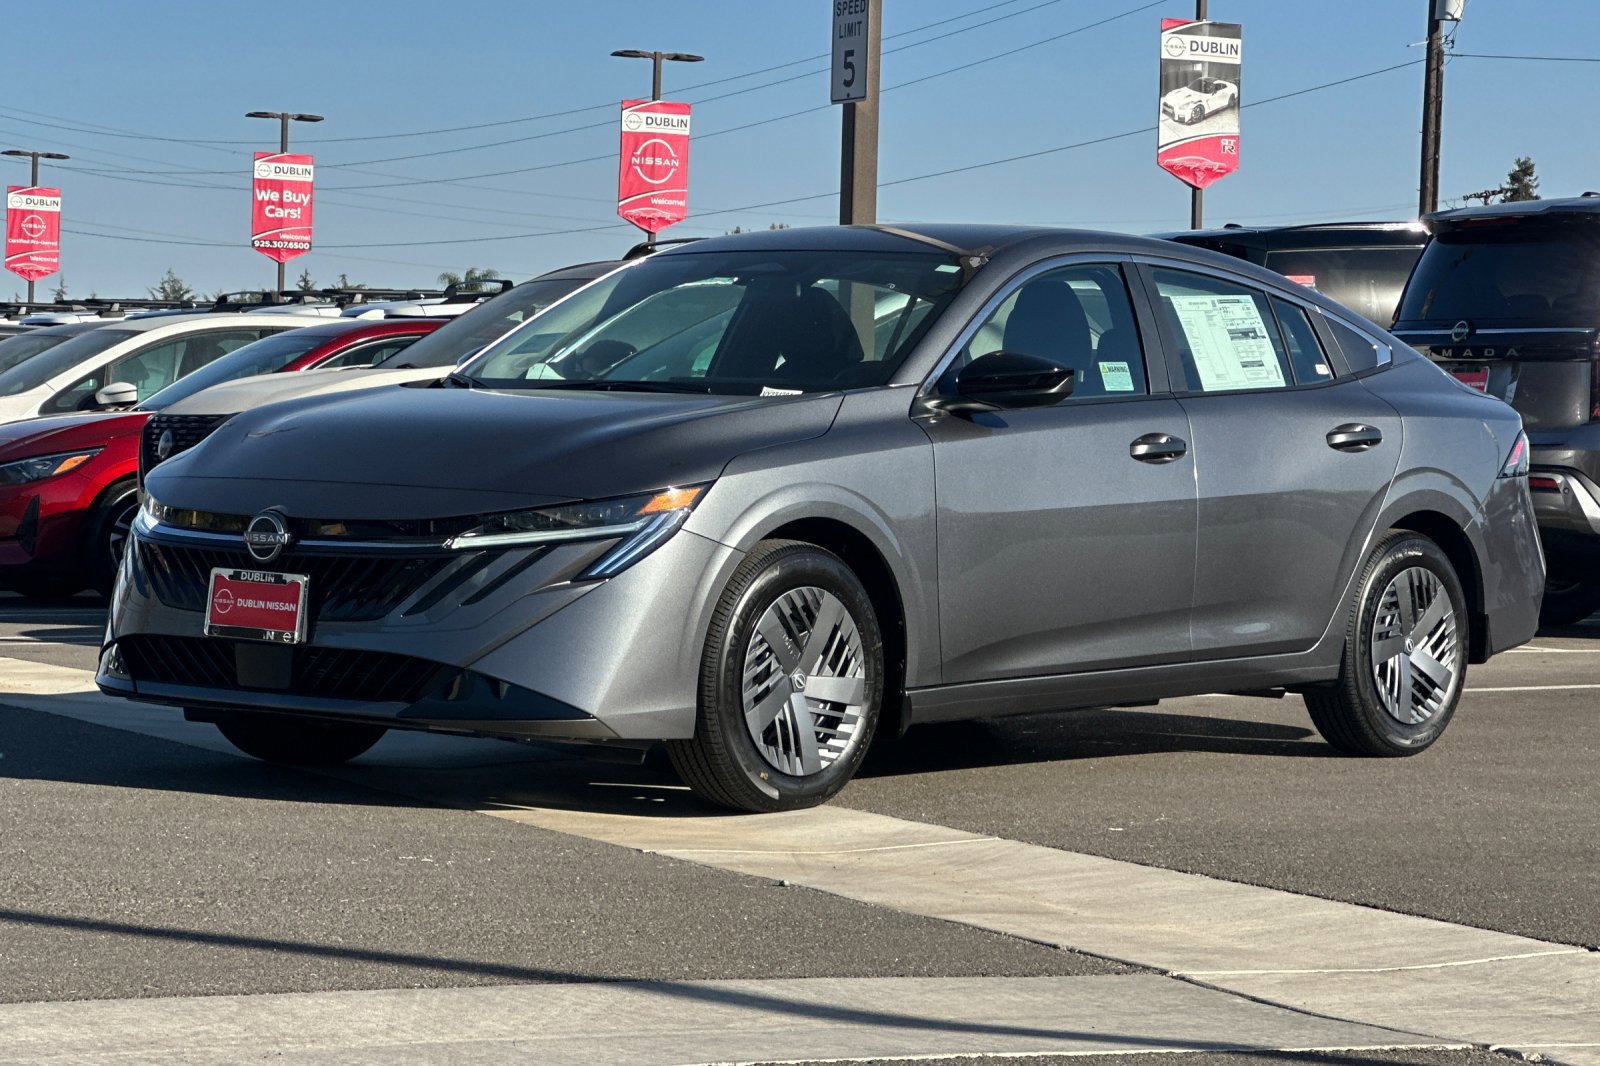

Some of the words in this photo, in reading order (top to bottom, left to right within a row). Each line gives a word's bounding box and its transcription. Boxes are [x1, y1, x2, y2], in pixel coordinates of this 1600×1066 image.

[837, 0, 866, 17] SPEED
[839, 21, 862, 38] LIMIT
[1190, 40, 1239, 56] DUBLIN
[843, 49, 856, 88] 5
[645, 116, 688, 129] DUBLIN
[631, 157, 680, 167] NISSAN
[274, 166, 311, 176] DUBLIN
[25, 197, 59, 206] DUBLIN
[256, 188, 280, 201] We
[283, 190, 311, 206] Buy
[264, 205, 301, 219] Cars!
[1425, 348, 1520, 358] MADA
[244, 532, 285, 544] NISSAN
[240, 572, 275, 584] DUBLIN
[237, 598, 265, 608] DUBLIN
[266, 601, 296, 612] NISSAN
